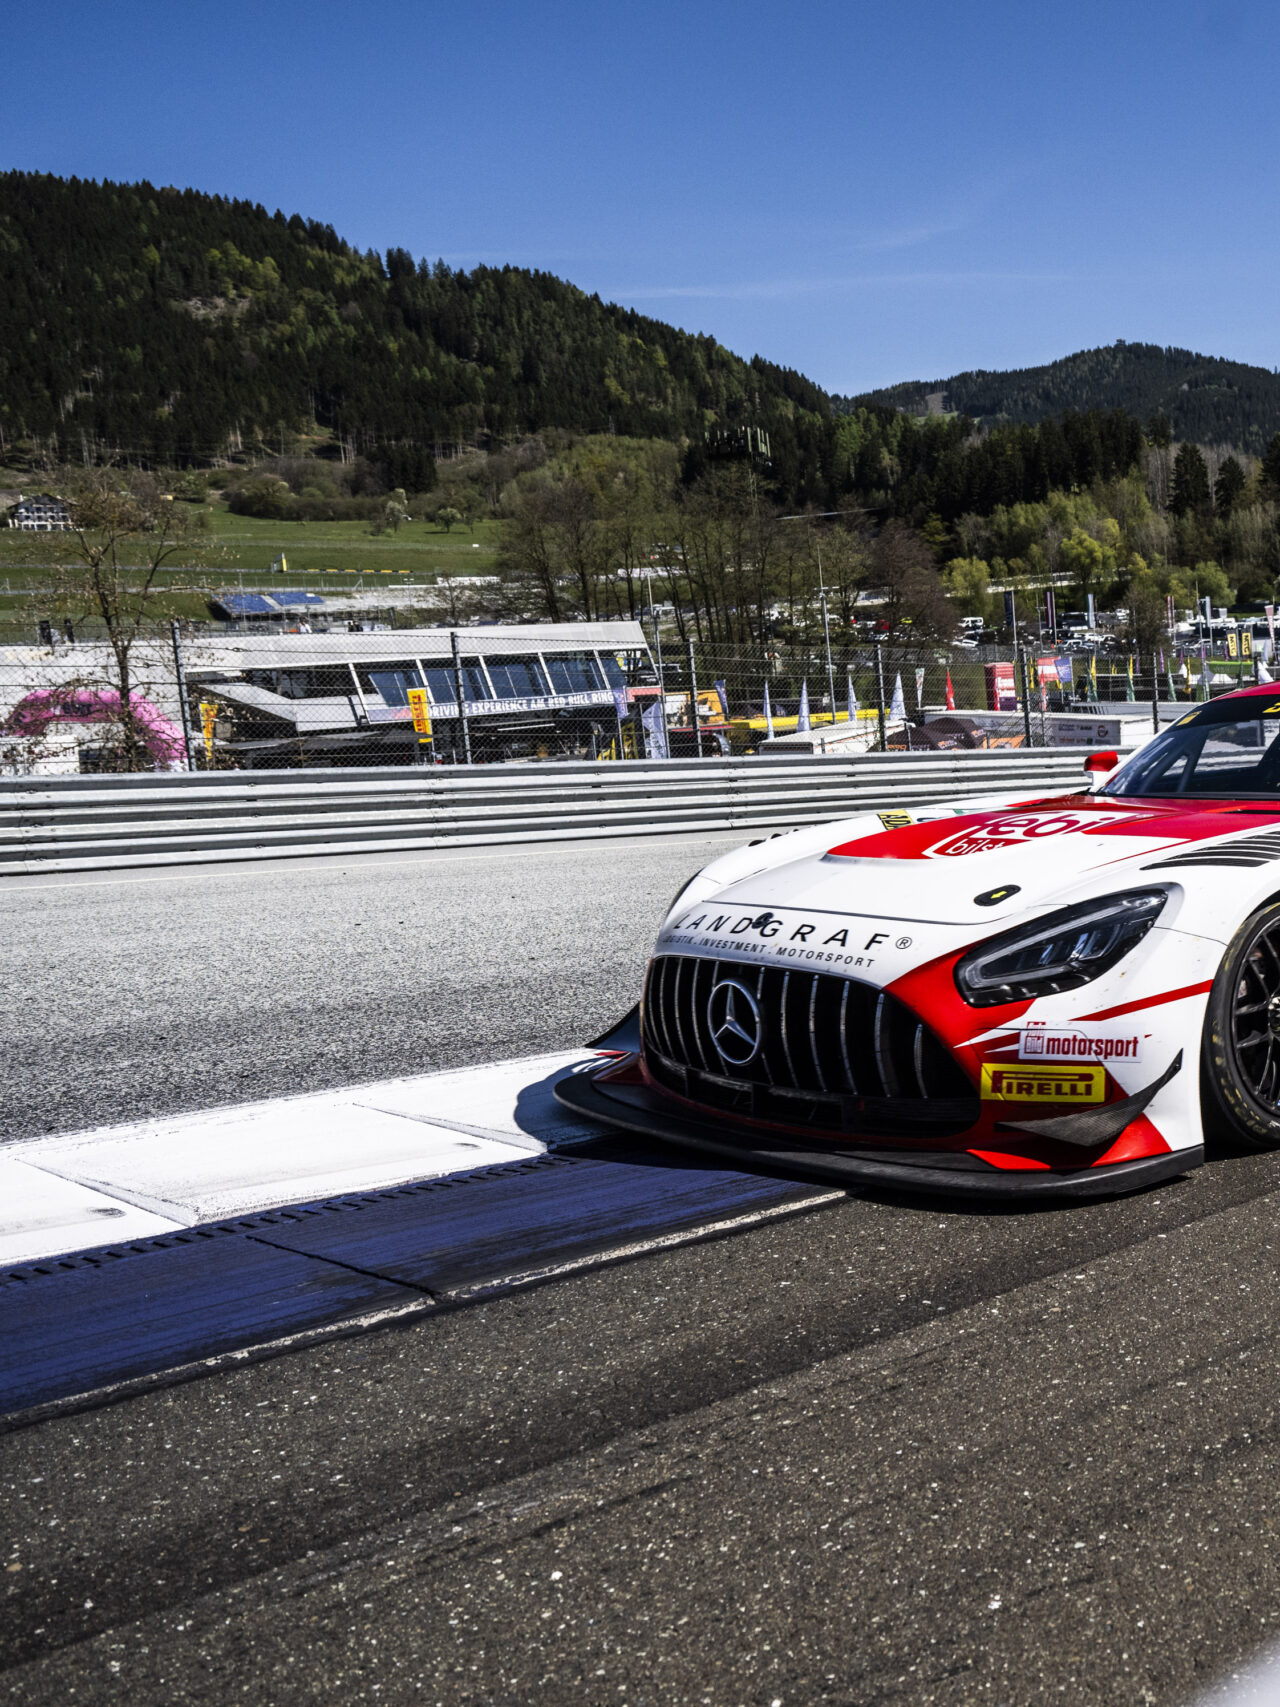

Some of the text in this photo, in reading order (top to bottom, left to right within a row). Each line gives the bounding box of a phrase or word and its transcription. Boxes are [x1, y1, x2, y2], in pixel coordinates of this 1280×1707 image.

[471, 700, 528, 714] EXPERIENCE
[592, 691, 614, 703] RING
[700, 938, 767, 953] INVESTMENT
[776, 946, 875, 968] MOTORSPORT
[1046, 1034, 1139, 1060] motorsport
[991, 1070, 1094, 1097] PIRELLI
